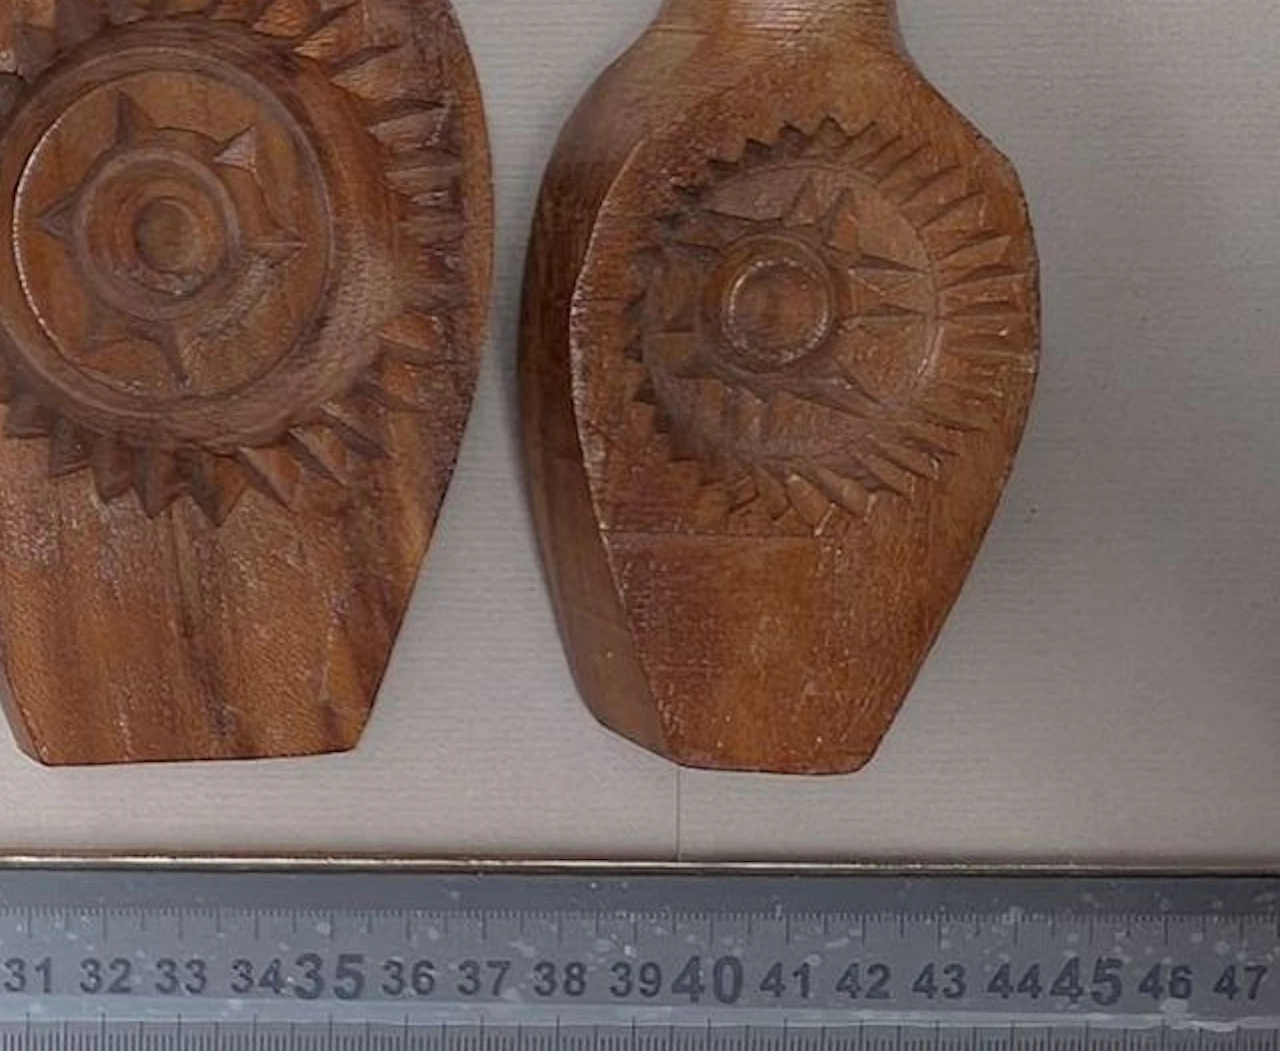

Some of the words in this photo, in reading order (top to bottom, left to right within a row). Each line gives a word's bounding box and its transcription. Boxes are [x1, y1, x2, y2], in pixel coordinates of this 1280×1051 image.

[3, 956, 53, 995] 31
[78, 957, 134, 995] 32
[154, 958, 208, 996] 33
[230, 958, 287, 996] 34
[293, 952, 365, 1001] 35
[381, 959, 436, 997] 36
[456, 959, 512, 998] 37
[532, 960, 587, 998] 38
[609, 961, 663, 999] 39
[671, 955, 744, 1006] 40
[759, 961, 811, 1000] 41
[835, 962, 891, 1000] 42
[911, 962, 967, 1000] 43
[987, 963, 1043, 1000] 44
[1049, 957, 1123, 1006] 45
[1138, 963, 1193, 1001] 46
[1212, 964, 1268, 1001] 47
